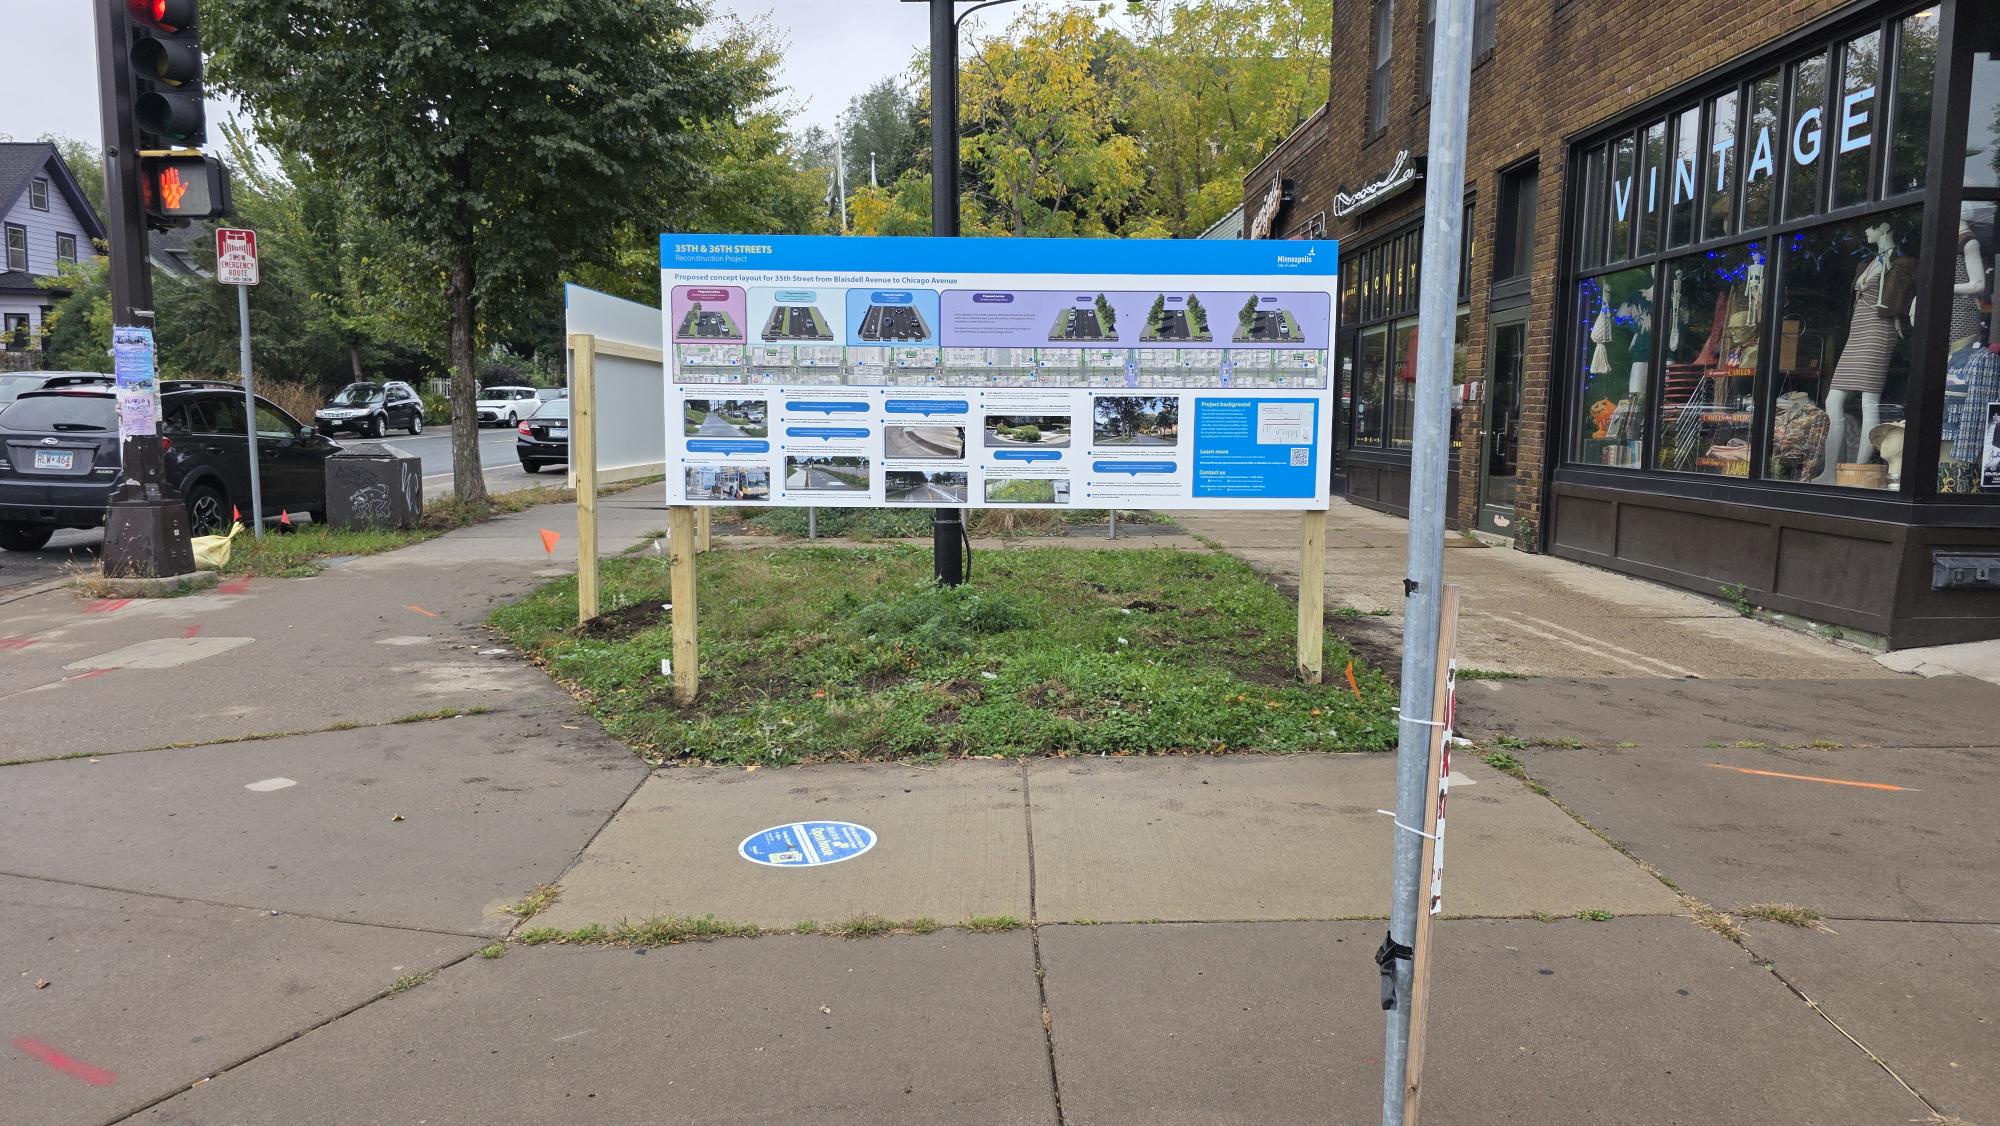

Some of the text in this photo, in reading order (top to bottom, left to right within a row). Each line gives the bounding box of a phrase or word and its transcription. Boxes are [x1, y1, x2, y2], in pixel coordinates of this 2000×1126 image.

[1615, 86, 1875, 222] VINTAGE
[675, 244, 698, 252] 35TH
[710, 245, 732, 253] 36TH
[734, 245, 772, 254] STREETS
[726, 255, 747, 263] Project
[1278, 256, 1312, 264] Minneapolis
[222, 261, 254, 269] EMERGENCY
[674, 274, 708, 282] Proposed
